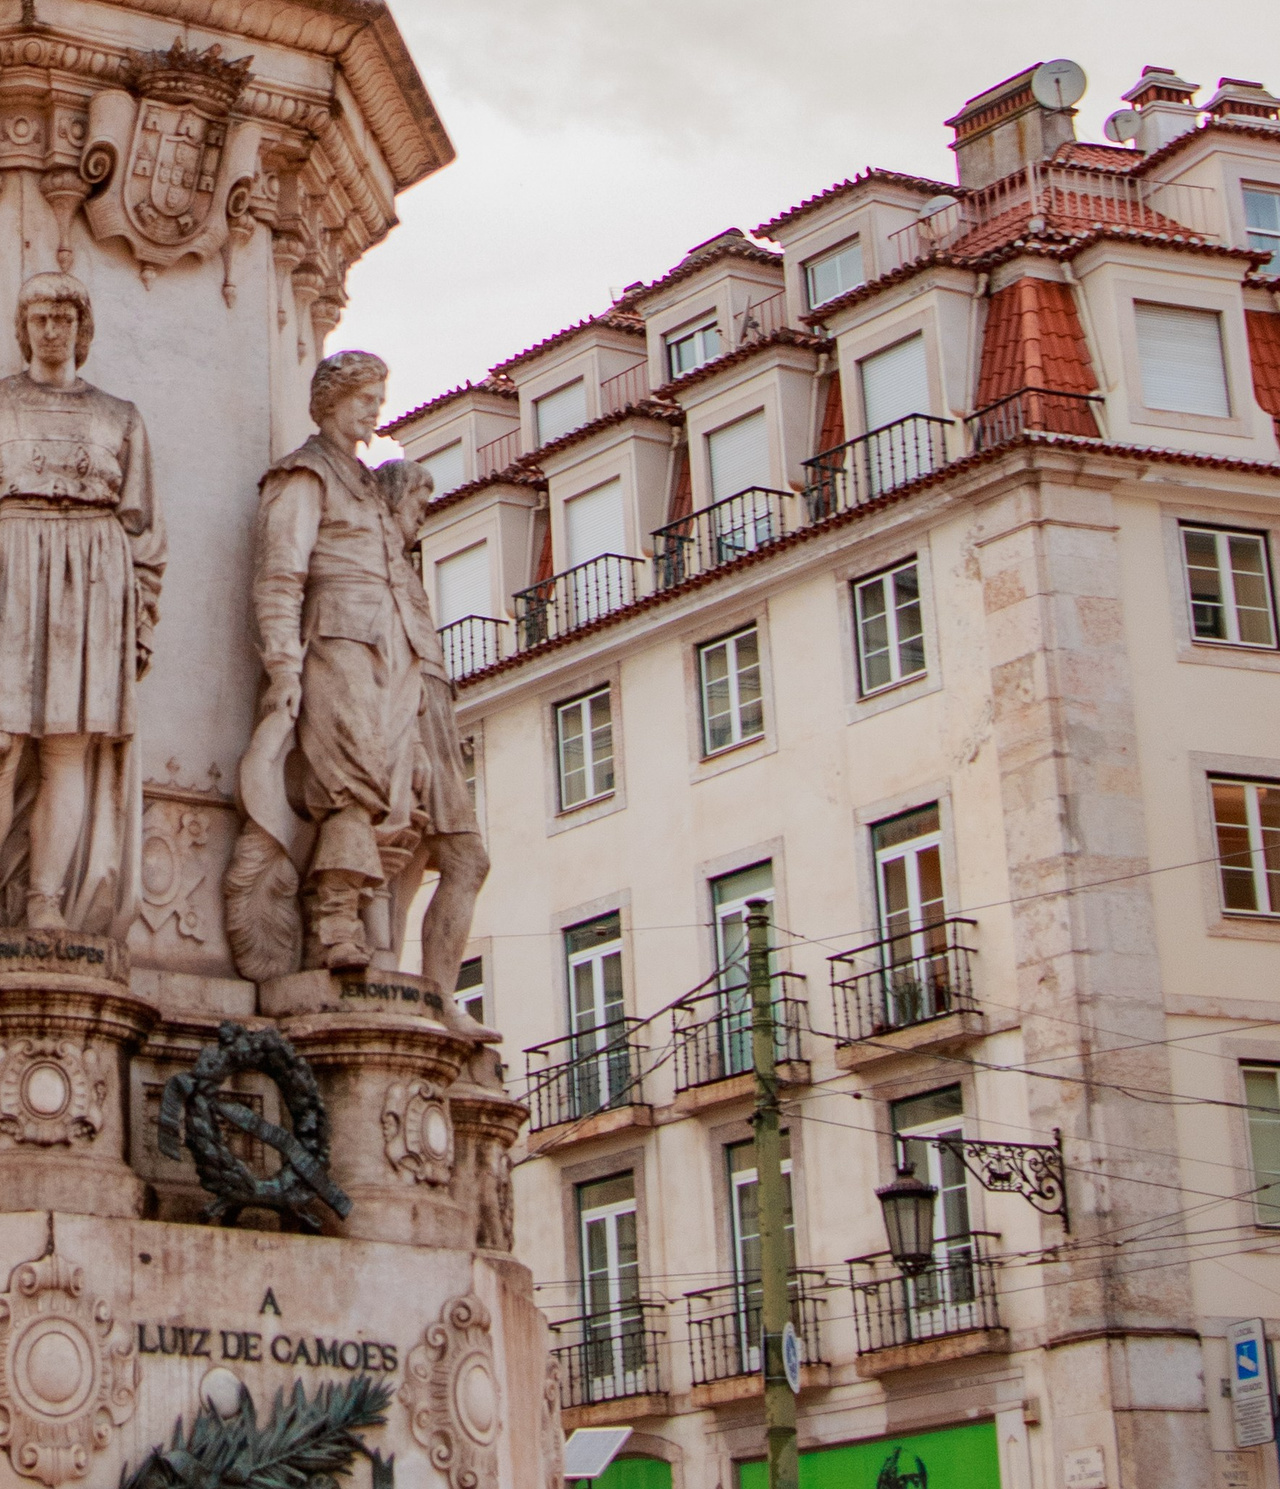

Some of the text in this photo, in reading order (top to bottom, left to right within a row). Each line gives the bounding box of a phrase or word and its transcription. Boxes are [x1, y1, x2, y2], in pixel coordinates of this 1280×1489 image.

[55, 939, 104, 964] LOPES
[259, 1286, 282, 1317] A
[137, 1323, 399, 1373] LUIZ DE CAMOES
